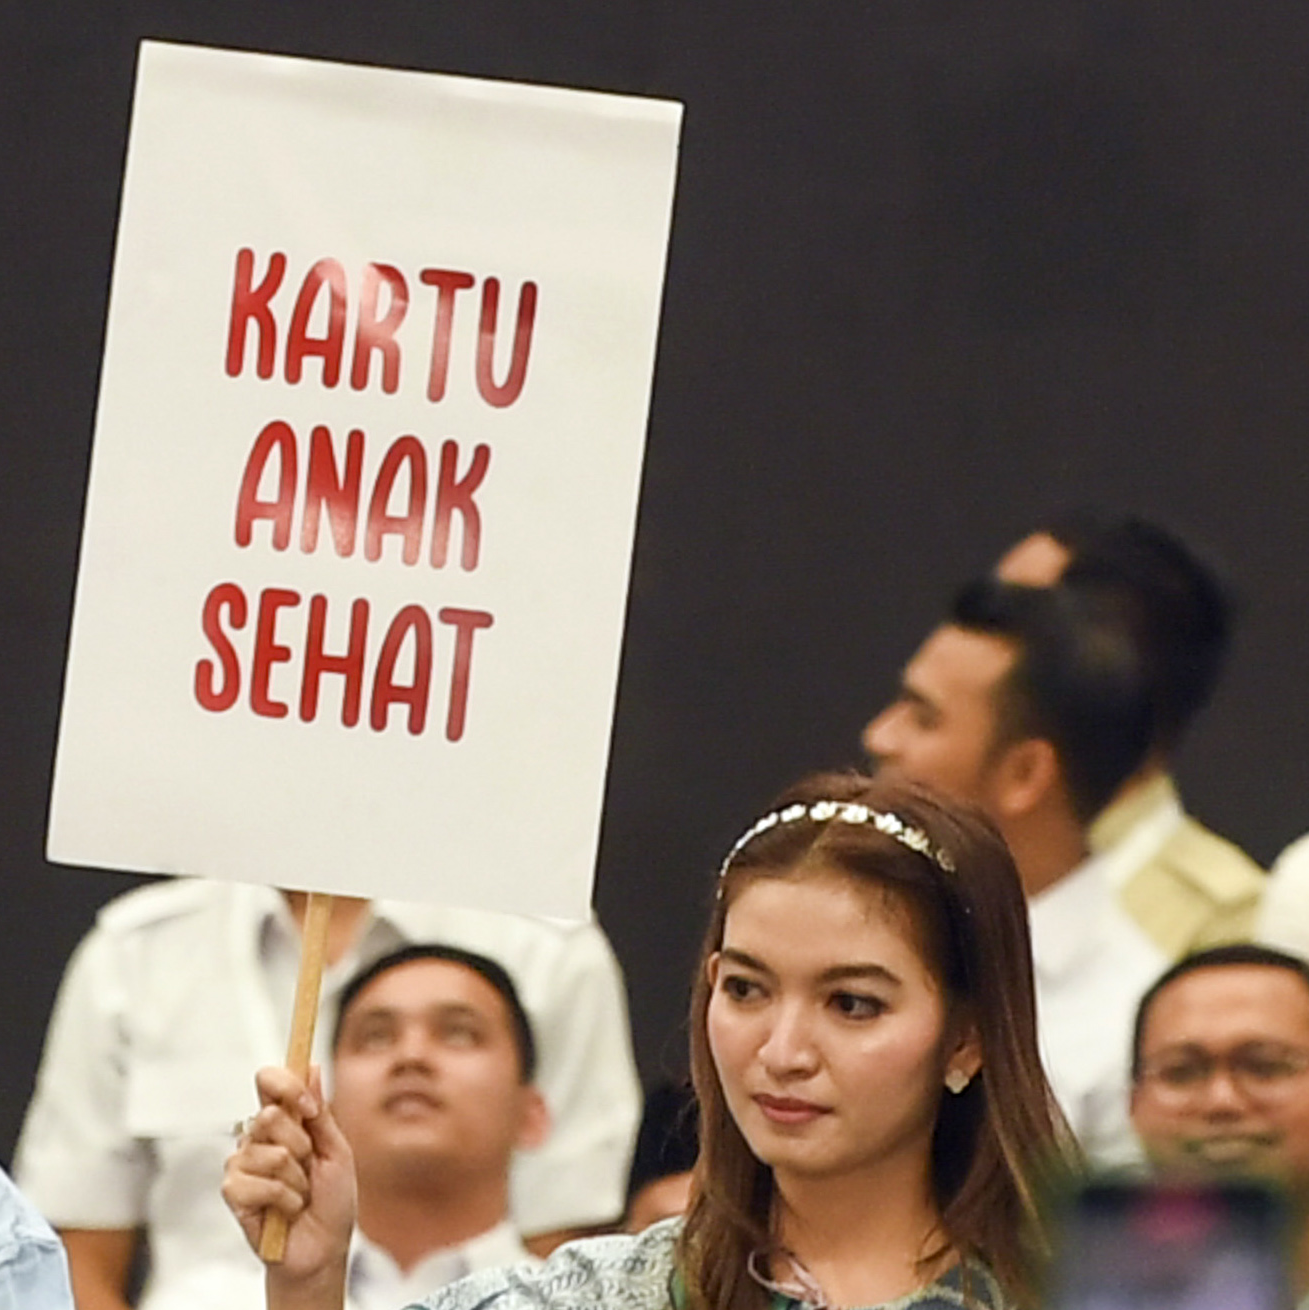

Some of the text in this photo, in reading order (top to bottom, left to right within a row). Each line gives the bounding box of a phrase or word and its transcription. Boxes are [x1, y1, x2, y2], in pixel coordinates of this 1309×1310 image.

[225, 247, 539, 409] KARTU
[234, 420, 492, 572] ANAK
[194, 583, 494, 742] SEHAT
